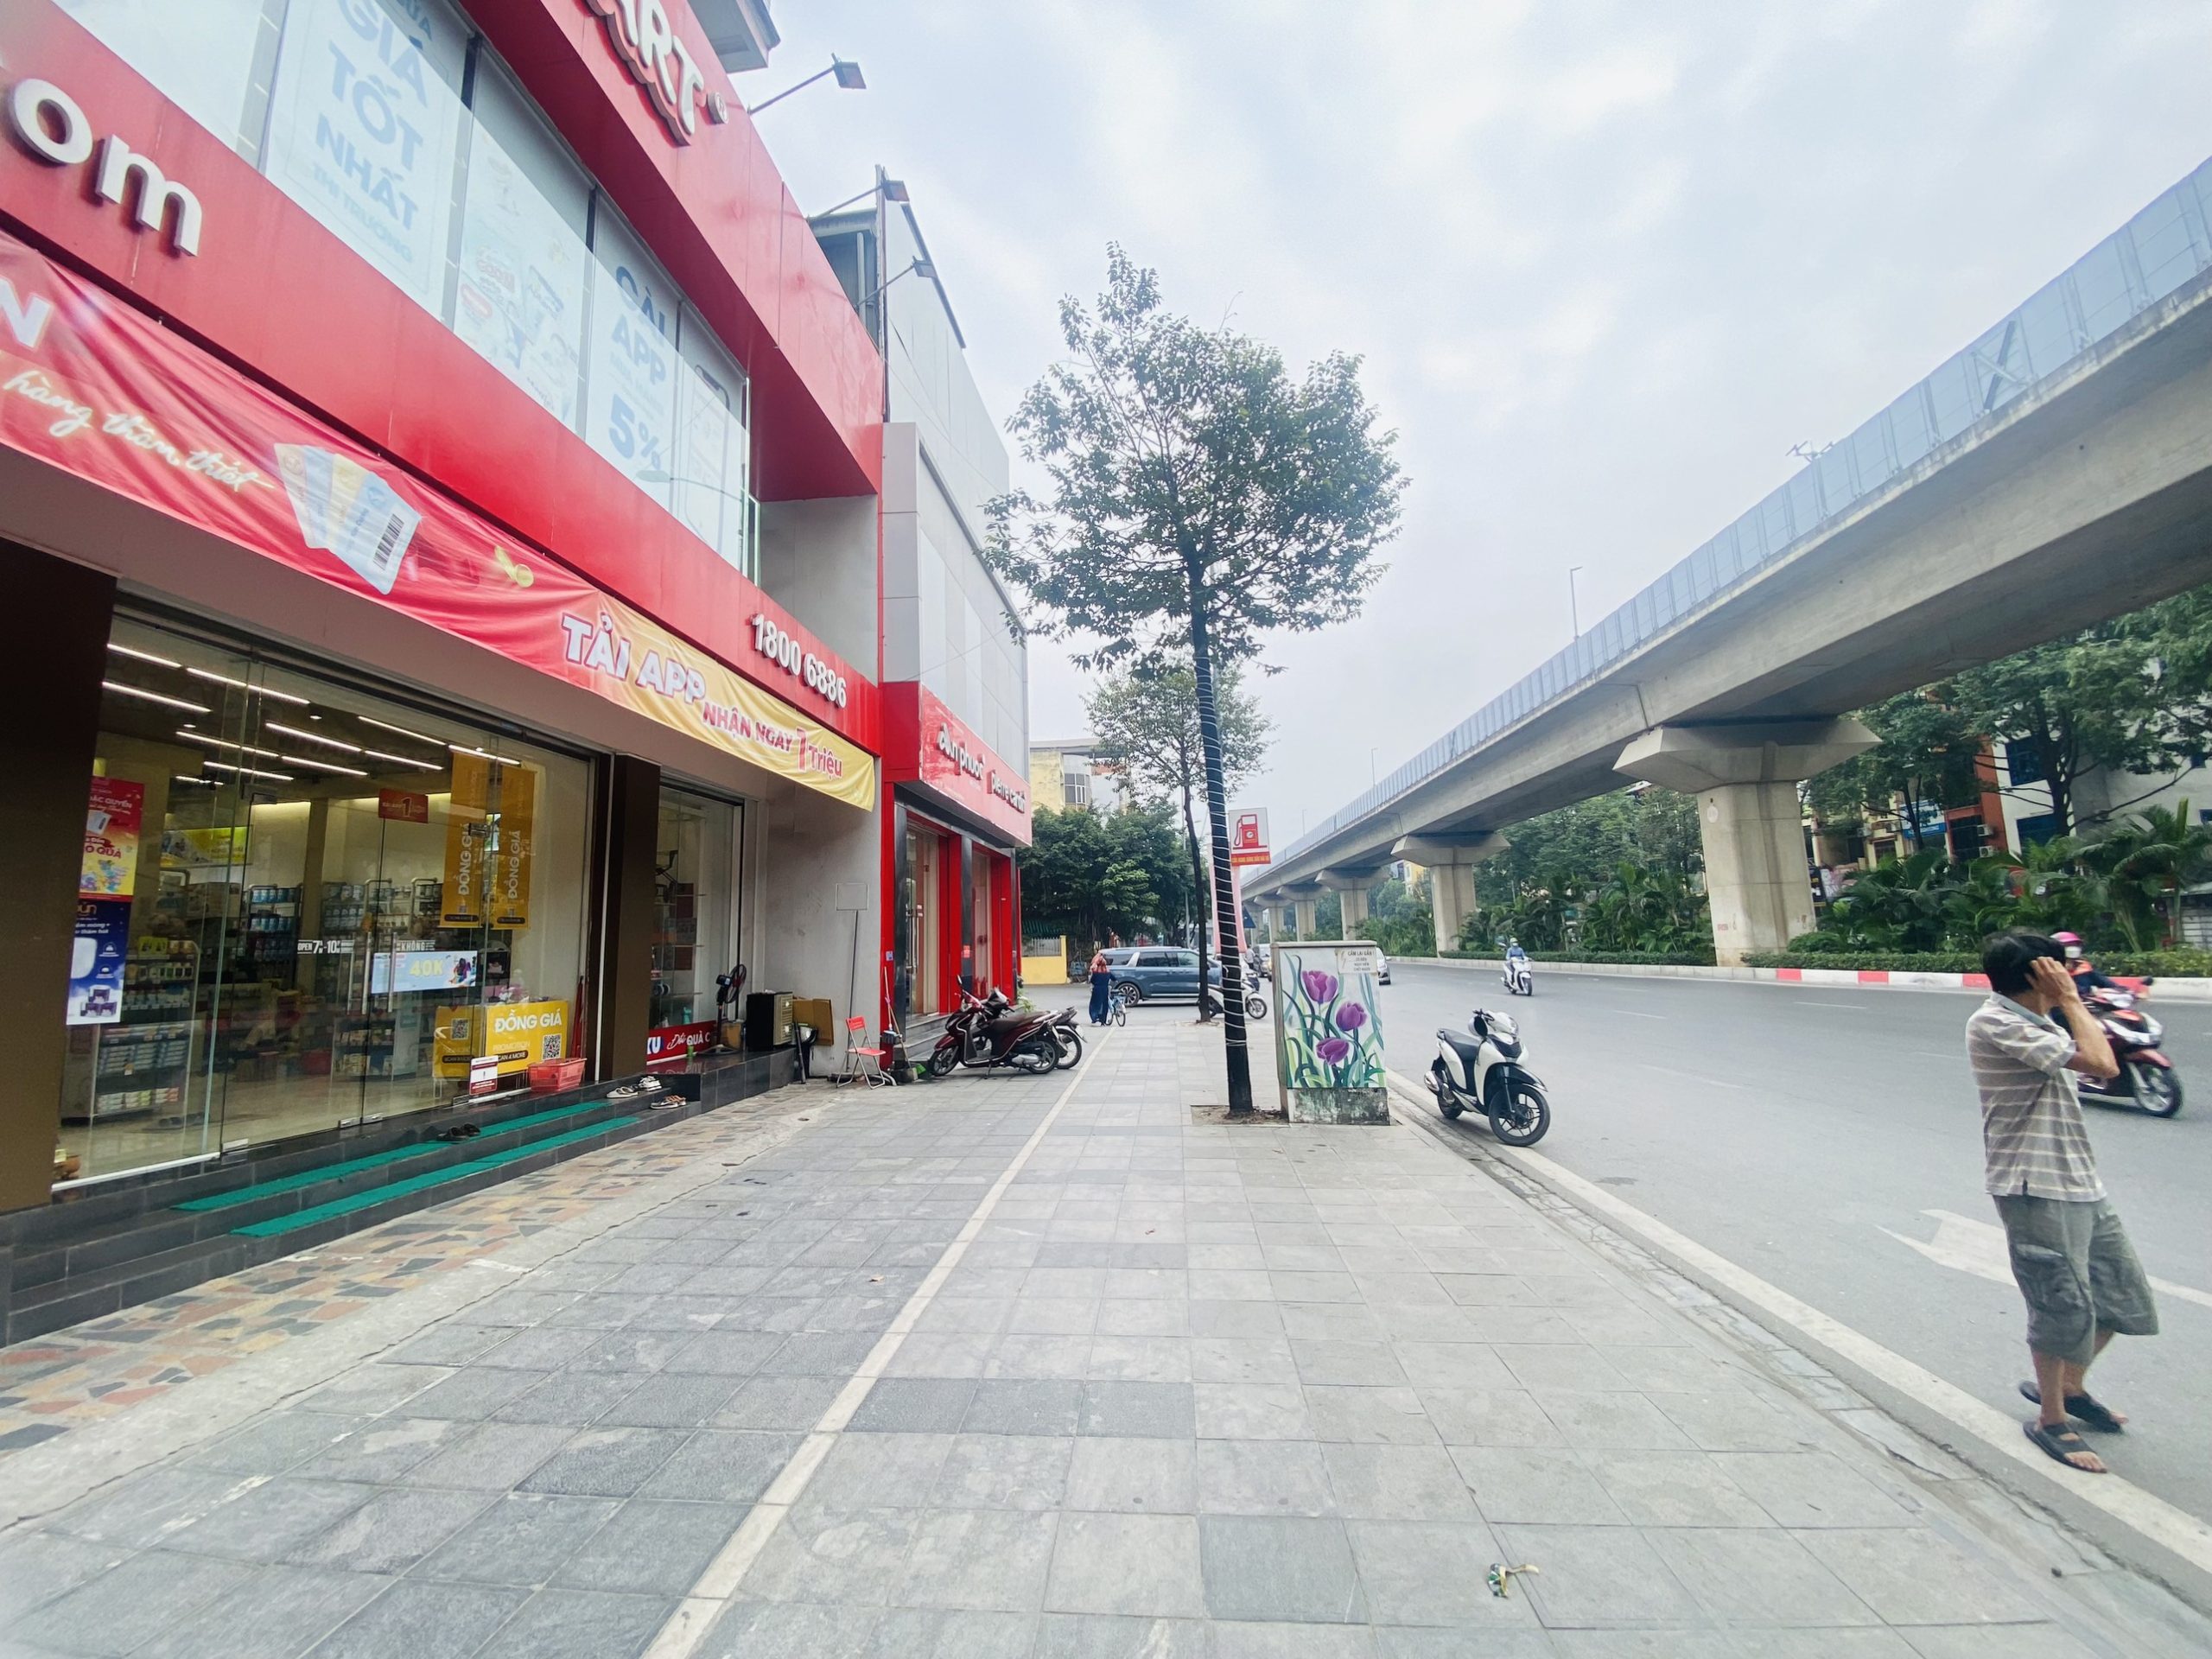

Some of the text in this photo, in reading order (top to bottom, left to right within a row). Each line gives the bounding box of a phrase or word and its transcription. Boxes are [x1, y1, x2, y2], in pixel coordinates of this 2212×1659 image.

[328, 38, 423, 172] TỐT
[316, 111, 418, 232] NHẤT
[616, 265, 665, 346] CÀI
[611, 314, 666, 385] APP
[3, 370, 92, 436] hàng
[608, 394, 662, 472] 5%
[562, 612, 843, 780] TẢI APP NHẬN NGAY 1 Triệu
[751, 613, 848, 709] 1800 6886
[297, 943, 313, 951] OPEN
[401, 940, 426, 951] KHÔNG
[494, 1008, 563, 1033] ĐỒNG GIÁ
[686, 1030, 704, 1046] QUÀ
